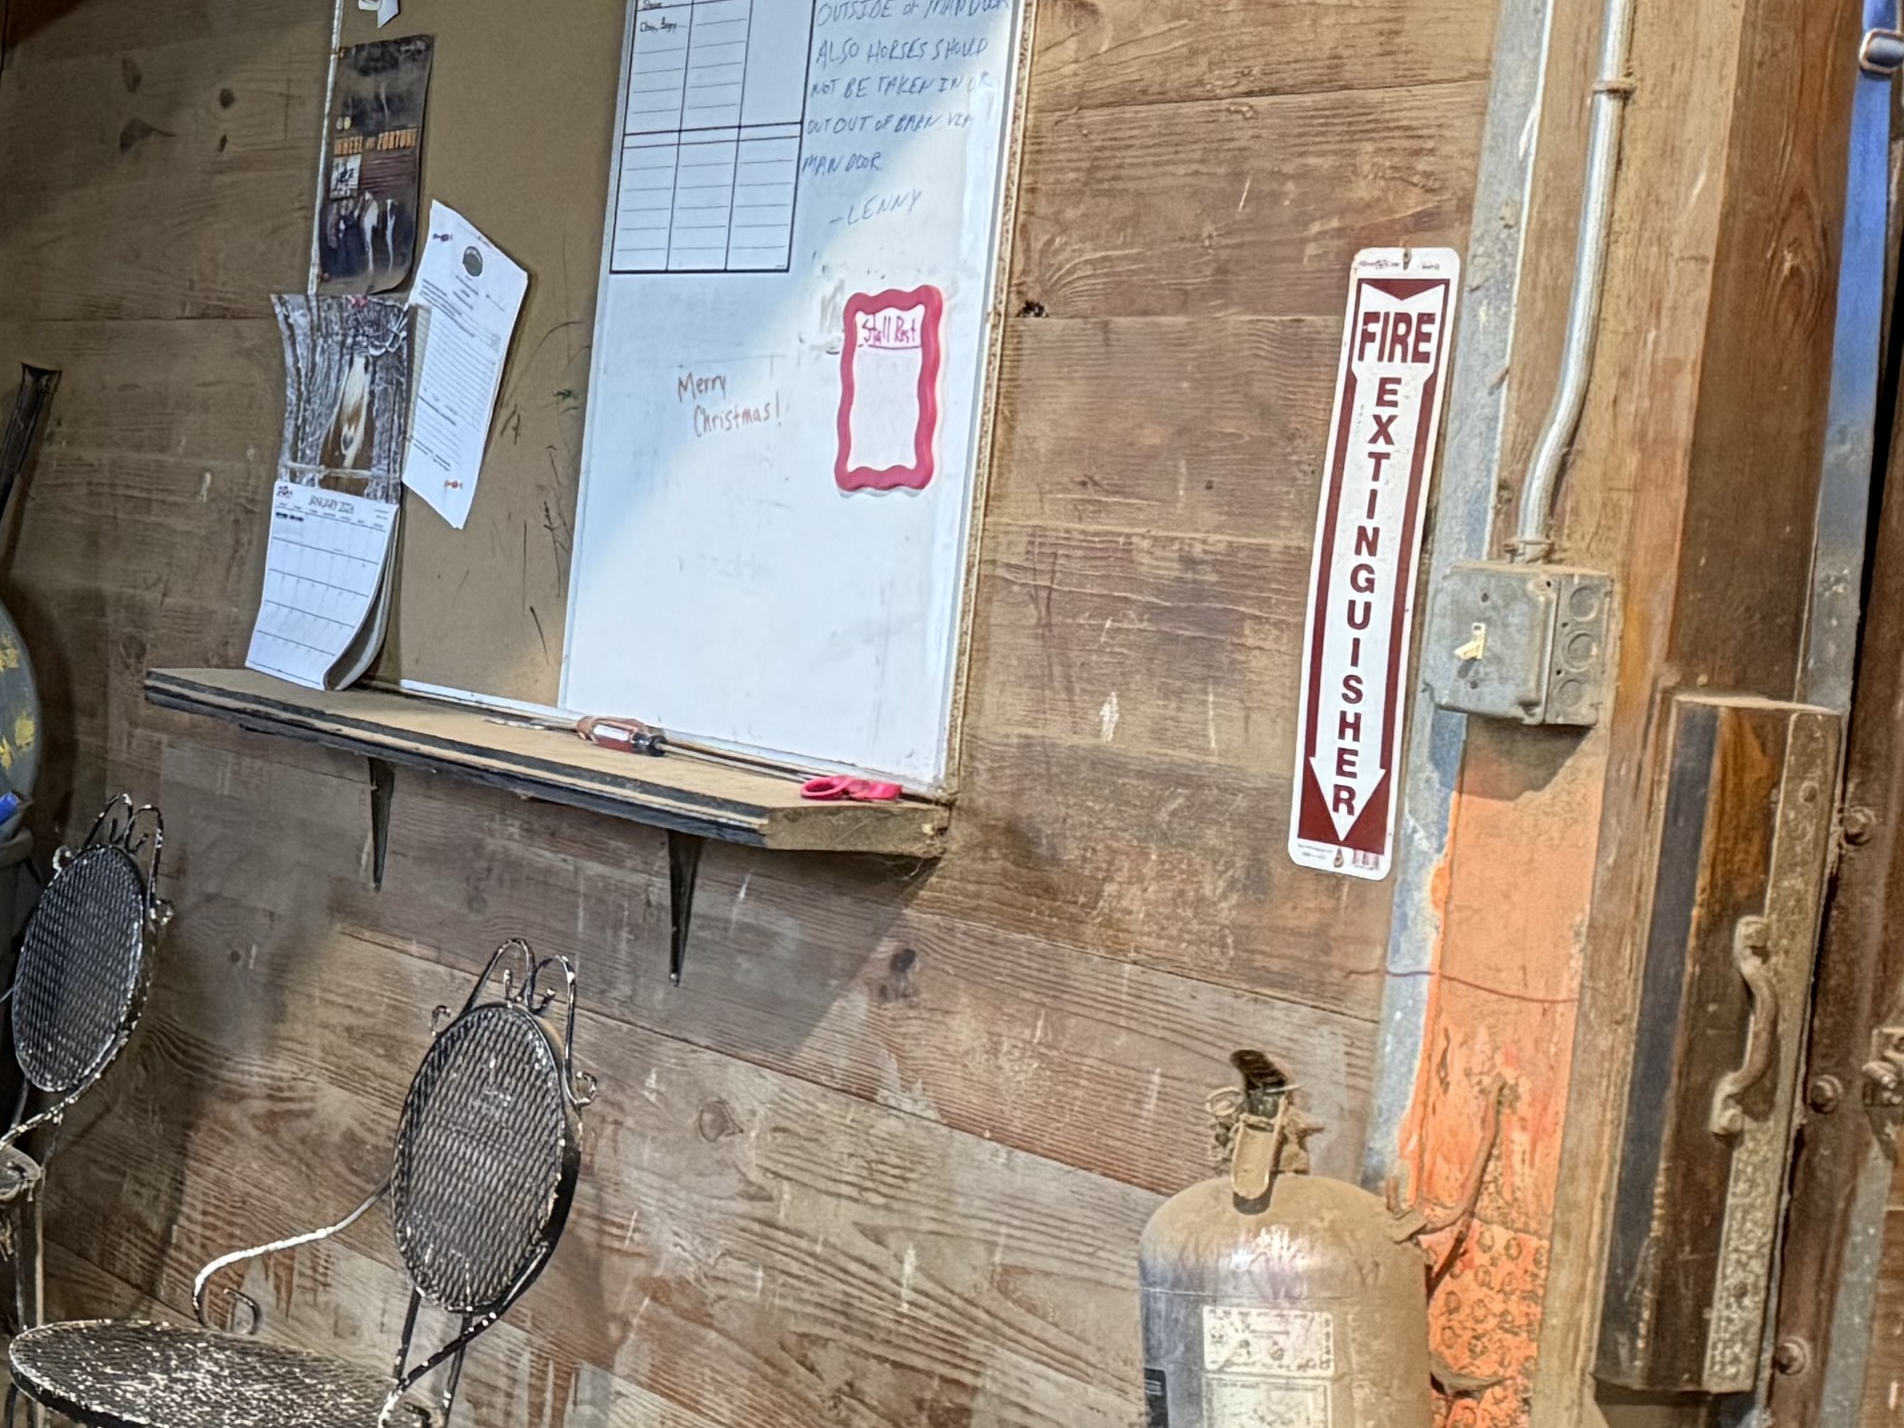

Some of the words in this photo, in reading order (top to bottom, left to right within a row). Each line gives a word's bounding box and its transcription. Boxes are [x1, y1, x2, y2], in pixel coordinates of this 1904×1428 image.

[816, 37, 860, 70] ALSO
[867, 37, 928, 67] HORSES
[932, 38, 988, 60] SHOULD
[811, 78, 841, 98] NOT
[844, 76, 871, 99] BE
[877, 72, 934, 95] TAKEN
[940, 77, 963, 93] IN
[833, 115, 872, 134] OUT
[894, 113, 940, 133] BARN
[802, 152, 841, 177] MAN
[845, 151, 883, 172] DOOR
[862, 313, 890, 345] Stall
[894, 316, 916, 343] Rest
[1358, 311, 1437, 365] FIRE
[677, 372, 727, 403] Merry
[694, 390, 781, 437] Christmas!
[1332, 376, 1402, 817] EXTINGUISHER
